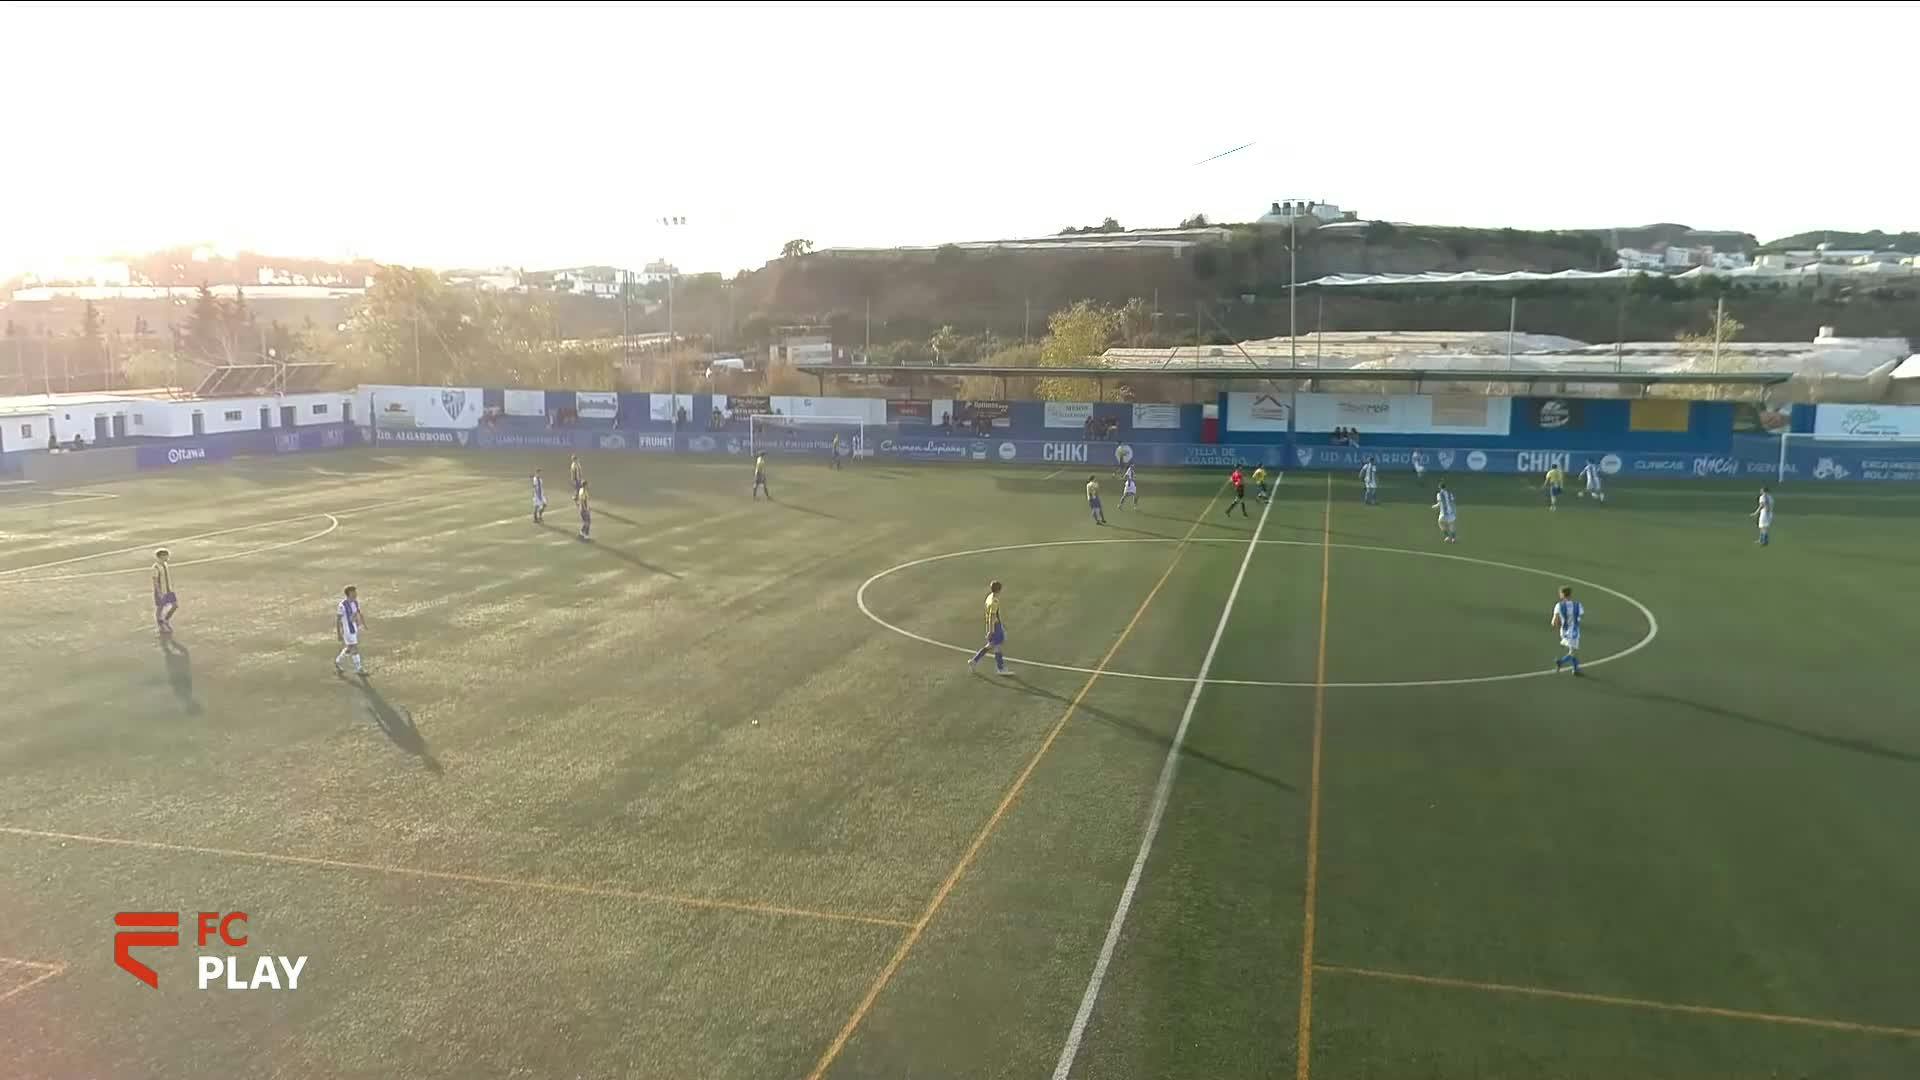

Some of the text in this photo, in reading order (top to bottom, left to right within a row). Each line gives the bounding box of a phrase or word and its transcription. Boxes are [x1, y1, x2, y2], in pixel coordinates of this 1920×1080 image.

[168, 448, 205, 463] Ottawa
[1042, 442, 1088, 462] CHIKI
[1343, 452, 1430, 465] ALARROO
[1517, 452, 1570, 472] CHIKI
